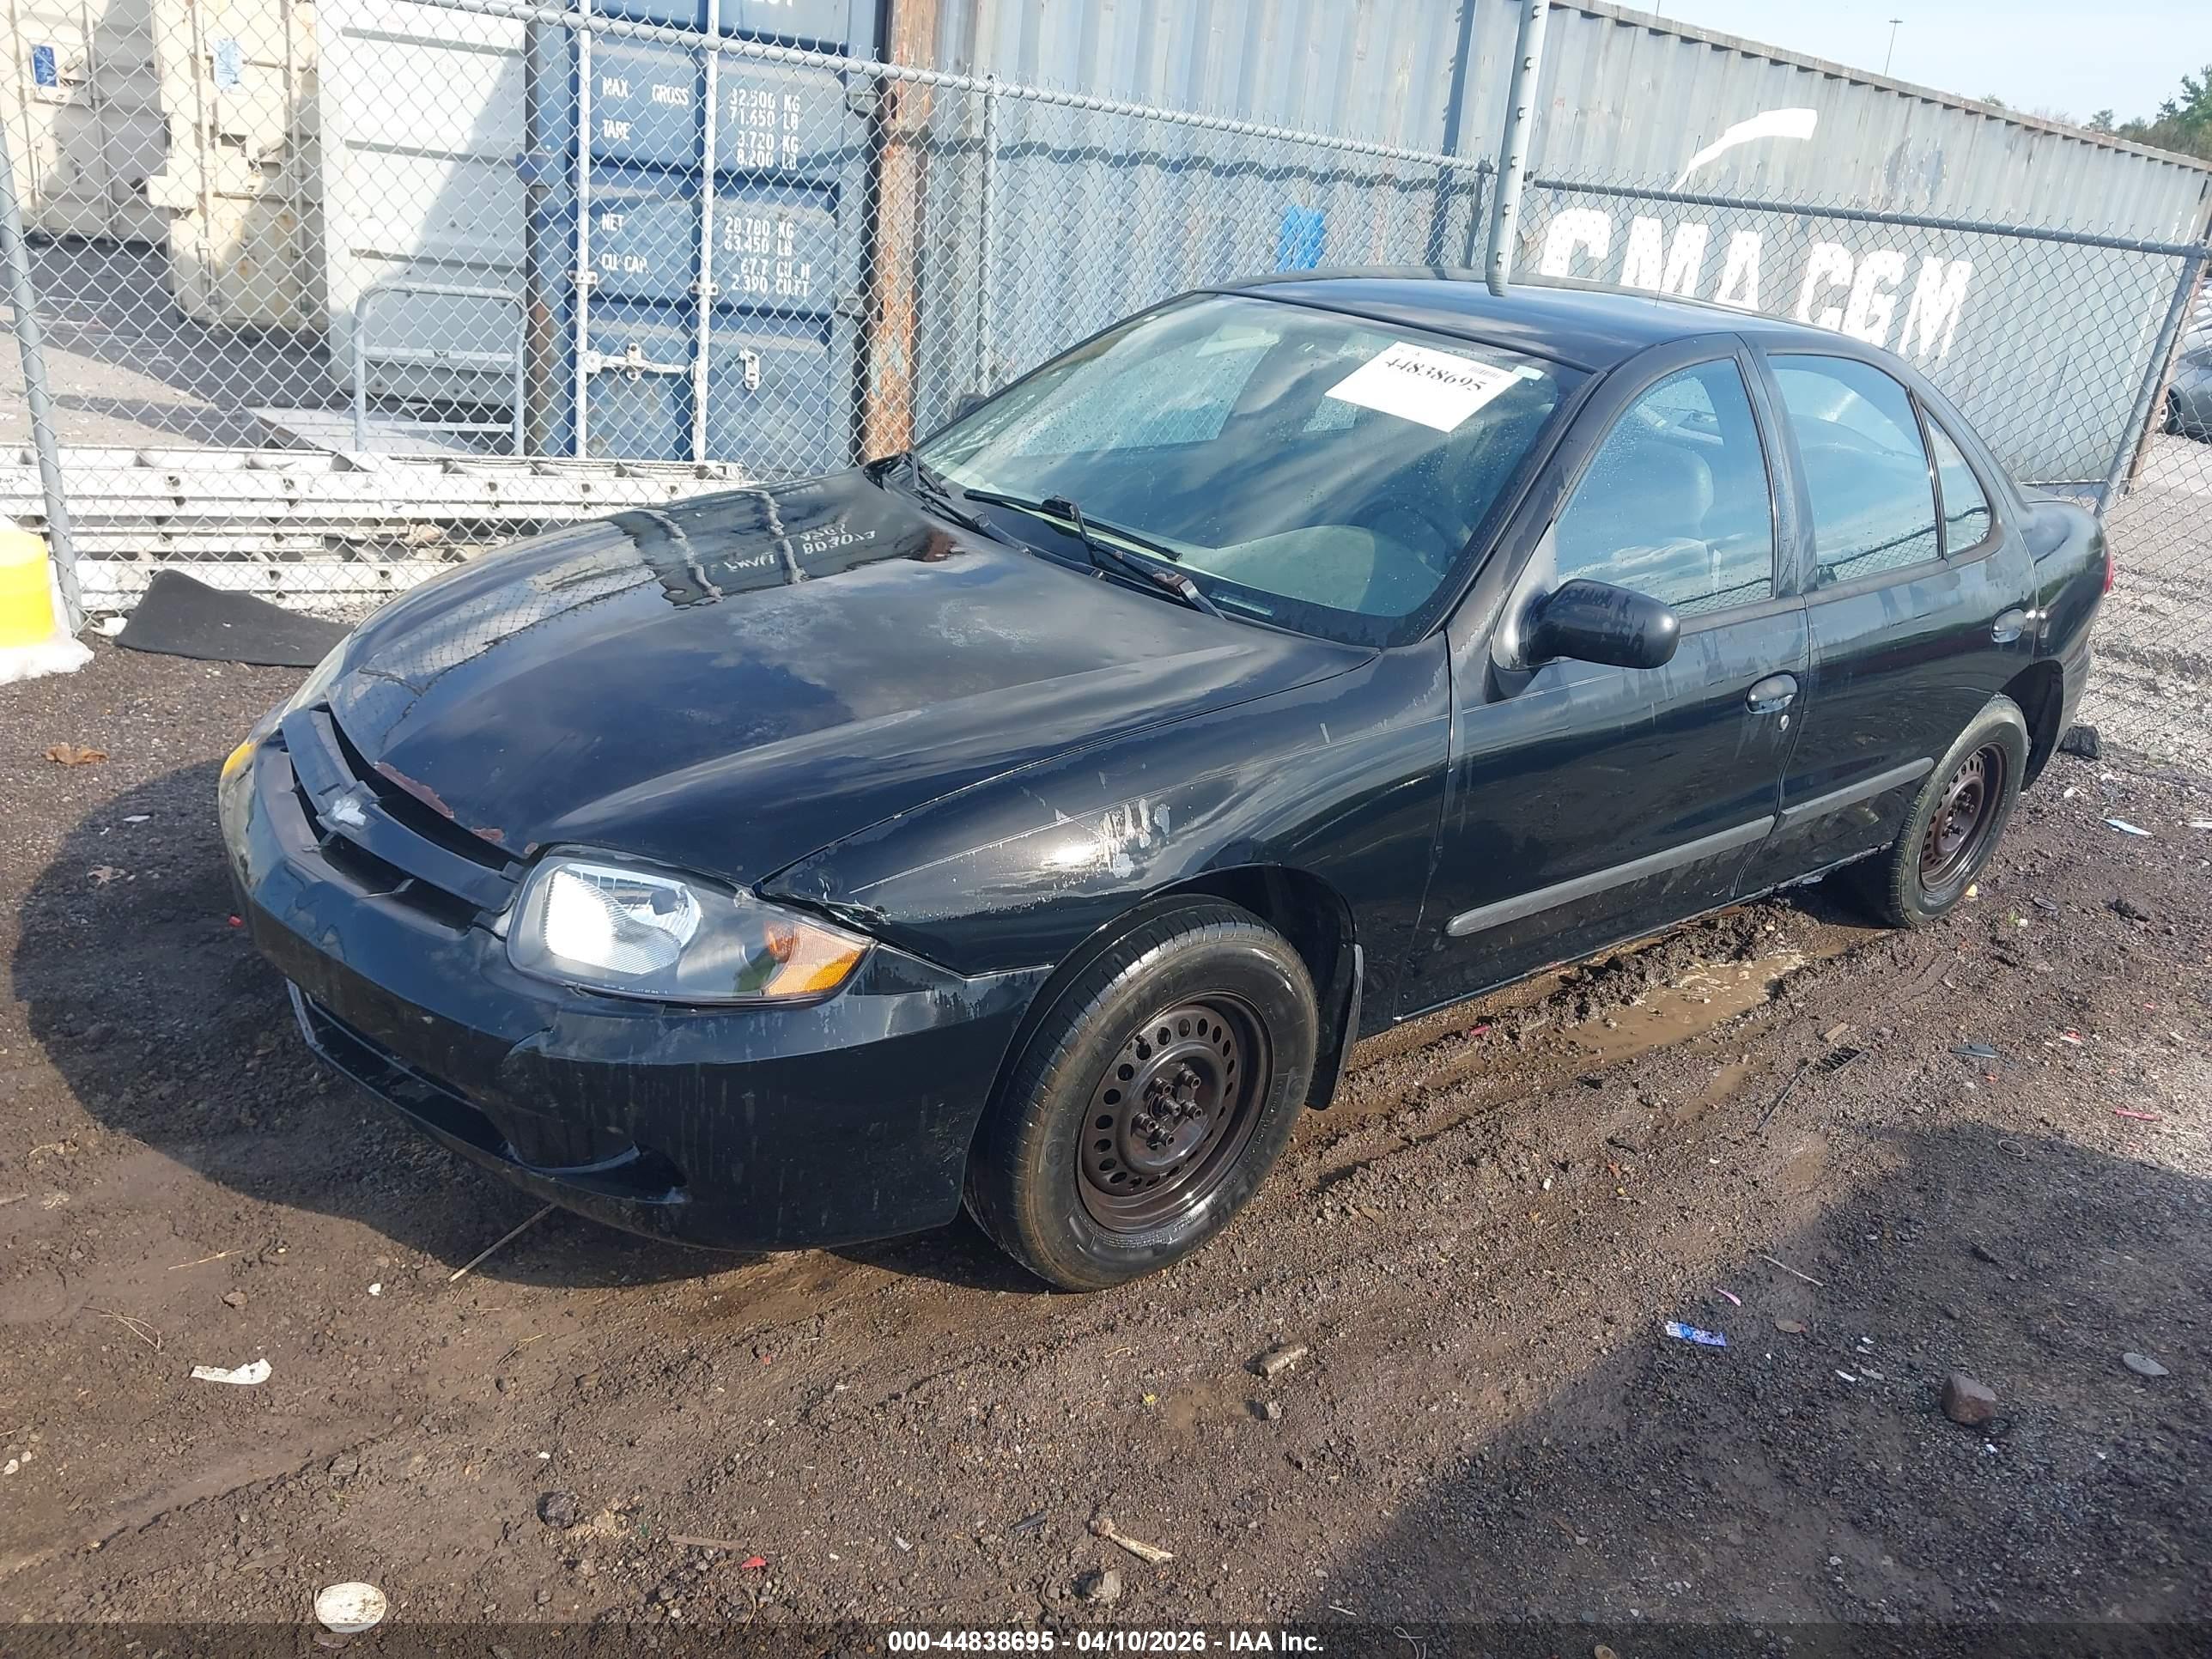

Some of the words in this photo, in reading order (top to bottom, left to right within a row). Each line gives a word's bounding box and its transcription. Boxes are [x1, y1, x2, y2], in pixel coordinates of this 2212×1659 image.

[652, 83, 690, 105] GROSS
[783, 94, 801, 112] KG
[602, 118, 631, 141] TARE
[782, 112, 799, 131] LB
[781, 135, 799, 154] KG
[781, 153, 797, 170] LB
[601, 212, 625, 232] NET
[778, 221, 794, 240] KG
[777, 239, 793, 257] LB
[1540, 208, 1763, 312] CMA
[1795, 241, 1973, 359] CGM
[1384, 357, 1488, 391] 44838695
